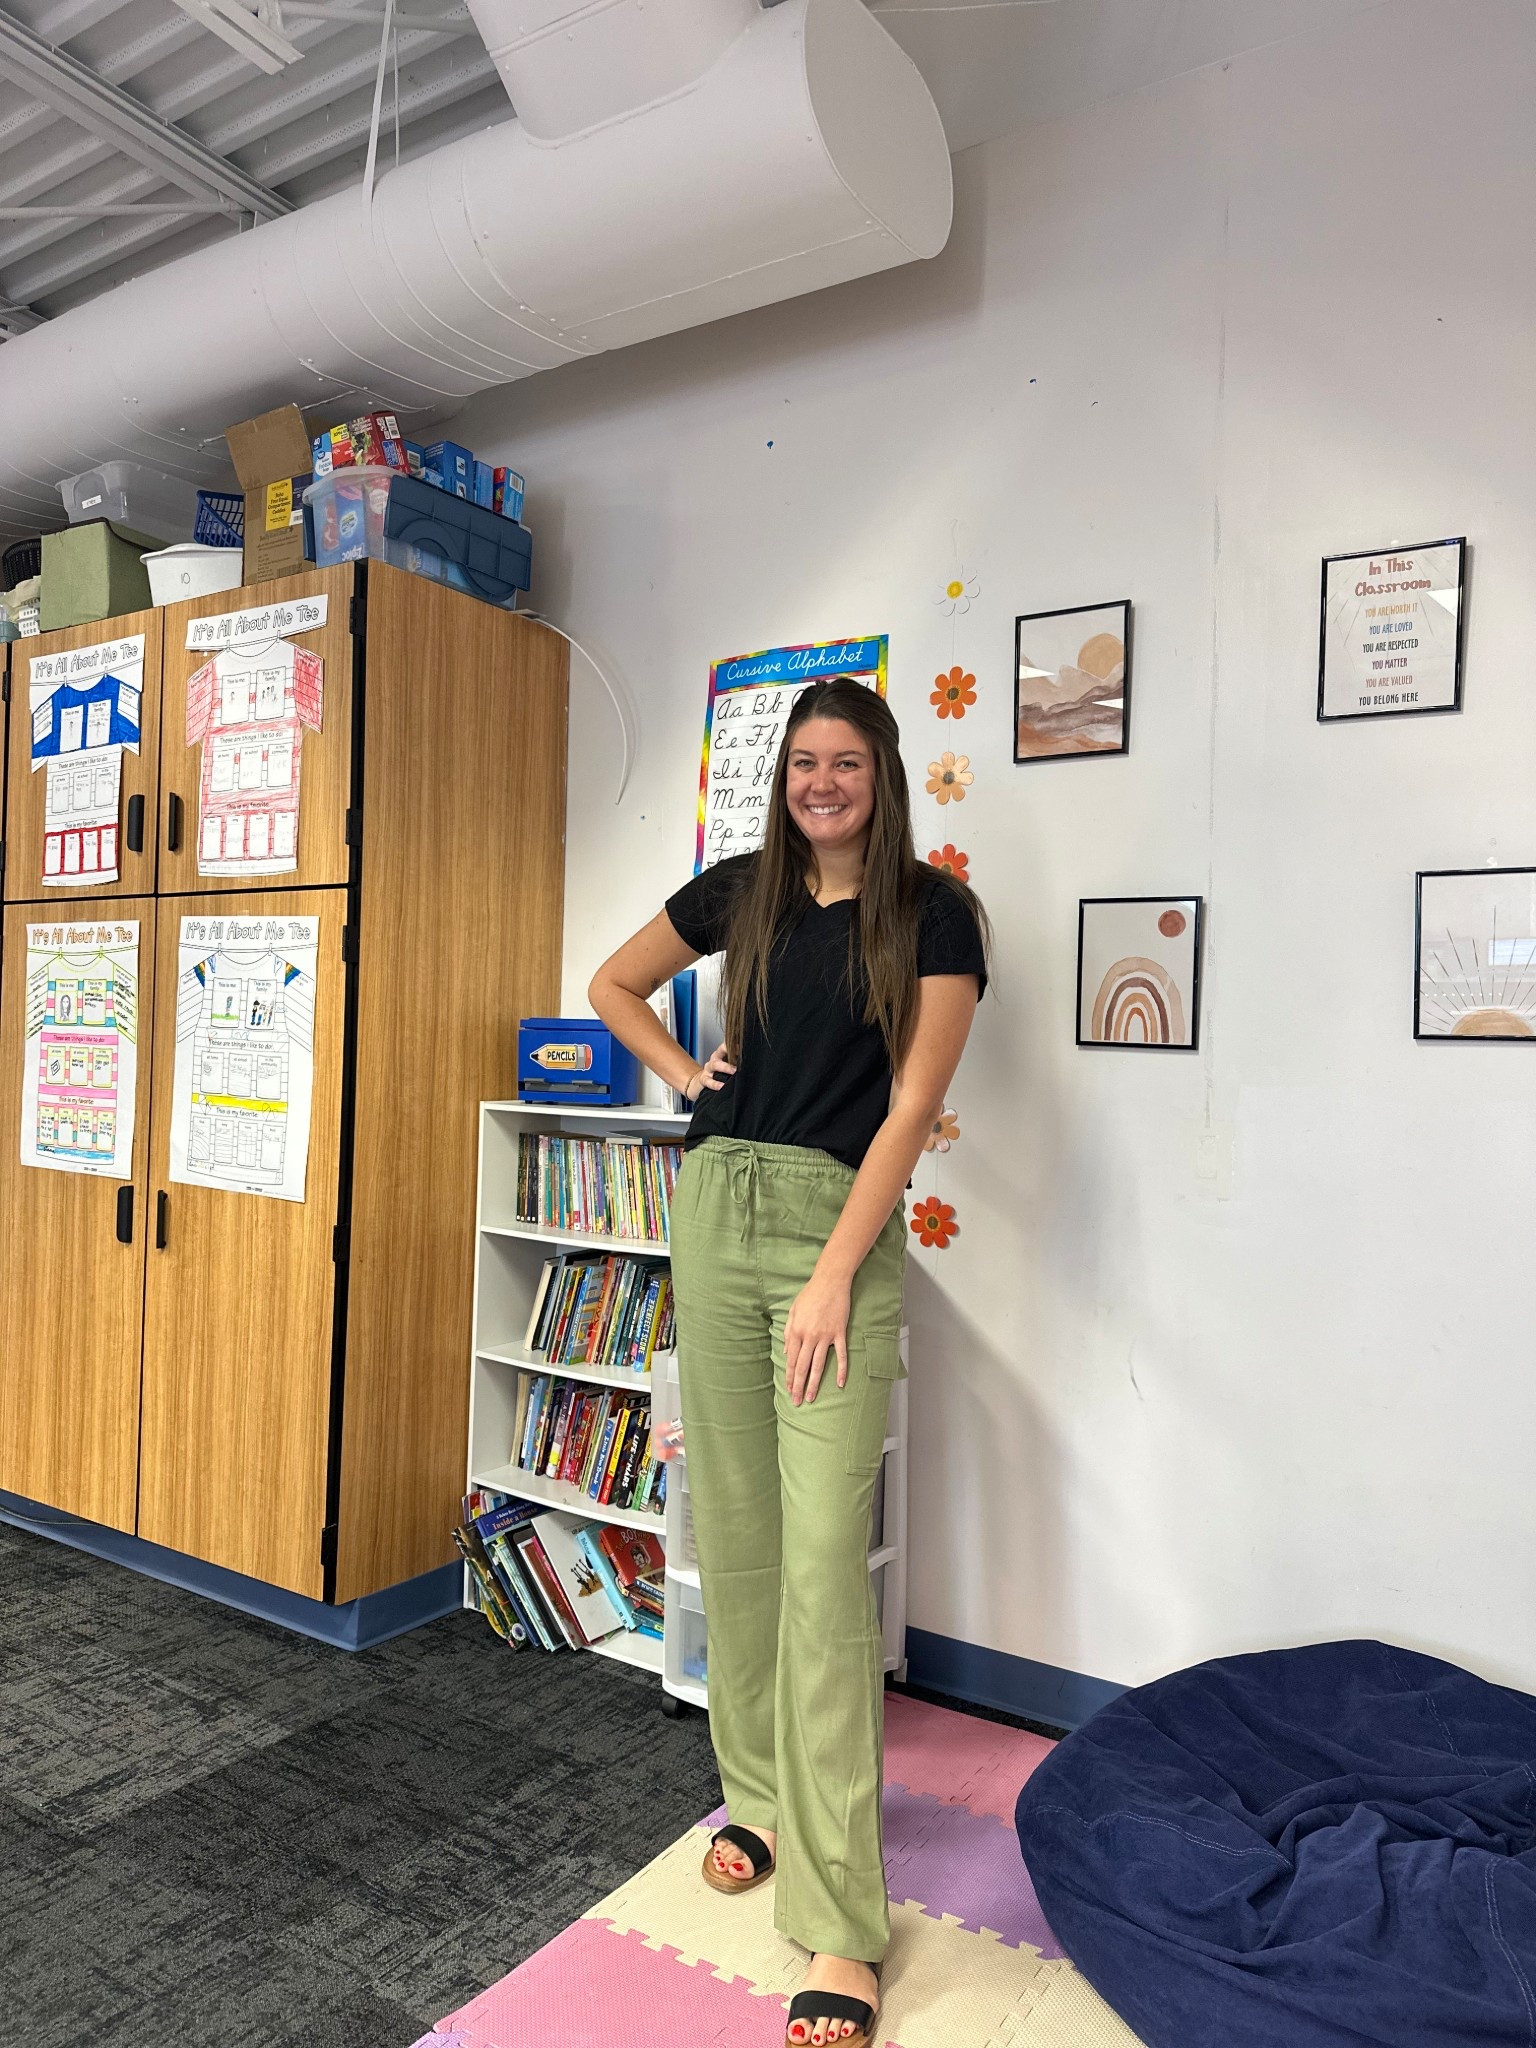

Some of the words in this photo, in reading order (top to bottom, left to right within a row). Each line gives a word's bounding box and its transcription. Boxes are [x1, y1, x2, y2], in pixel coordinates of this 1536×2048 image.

[1369, 561, 1381, 575] In
[1387, 558, 1414, 573] This
[1355, 579, 1432, 597] Classroom
[1365, 607, 1375, 617] YOU
[1378, 606, 1389, 616] ARE
[1390, 604, 1410, 615] WORTH
[1412, 603, 1418, 612] IT
[193, 624, 214, 642] It's
[217, 619, 232, 639] All
[235, 612, 270, 636] About
[273, 608, 293, 628] Me
[296, 605, 319, 622] Tee
[1369, 625, 1380, 635] YOU
[1382, 623, 1393, 633] ARE
[1395, 622, 1412, 631] LOVED
[1363, 643, 1373, 653] YOU
[1375, 642, 1386, 652] ARE
[1388, 639, 1418, 650] RESPECTED
[35, 660, 53, 679] It's
[55, 657, 68, 675] All
[71, 650, 99, 672] About
[101, 647, 117, 665] Me
[120, 644, 139, 659] Tee
[727, 661, 782, 681] Cursive
[787, 643, 863, 676] Alphabet
[1372, 659, 1383, 669] YOU
[1385, 658, 1408, 668] MATTER
[1366, 678, 1376, 688] YOU
[1378, 677, 1389, 687] ARE
[1391, 675, 1413, 685] VALUED
[1359, 697, 1371, 706] YOU
[1374, 694, 1399, 705] BELONG
[1402, 692, 1419, 703] HERE
[33, 929, 49, 945] It's
[52, 928, 63, 945] All
[66, 927, 94, 944] About
[96, 927, 112, 943] Me
[115, 927, 133, 942] Tee
[186, 922, 206, 940] It's
[209, 921, 223, 940] All
[227, 921, 262, 941] About
[265, 921, 284, 941] Me
[288, 922, 311, 941] Tee
[547, 1050, 576, 1062] PENCILS
[644, 1304, 655, 1335] PERFECT
[638, 1335, 649, 1356] SCORE
[632, 1435, 640, 1454] LIFE
[621, 1463, 633, 1488] MARS
[492, 1517, 513, 1530] Inside
[520, 1507, 538, 1519] House
[621, 1529, 637, 1544] BOY
